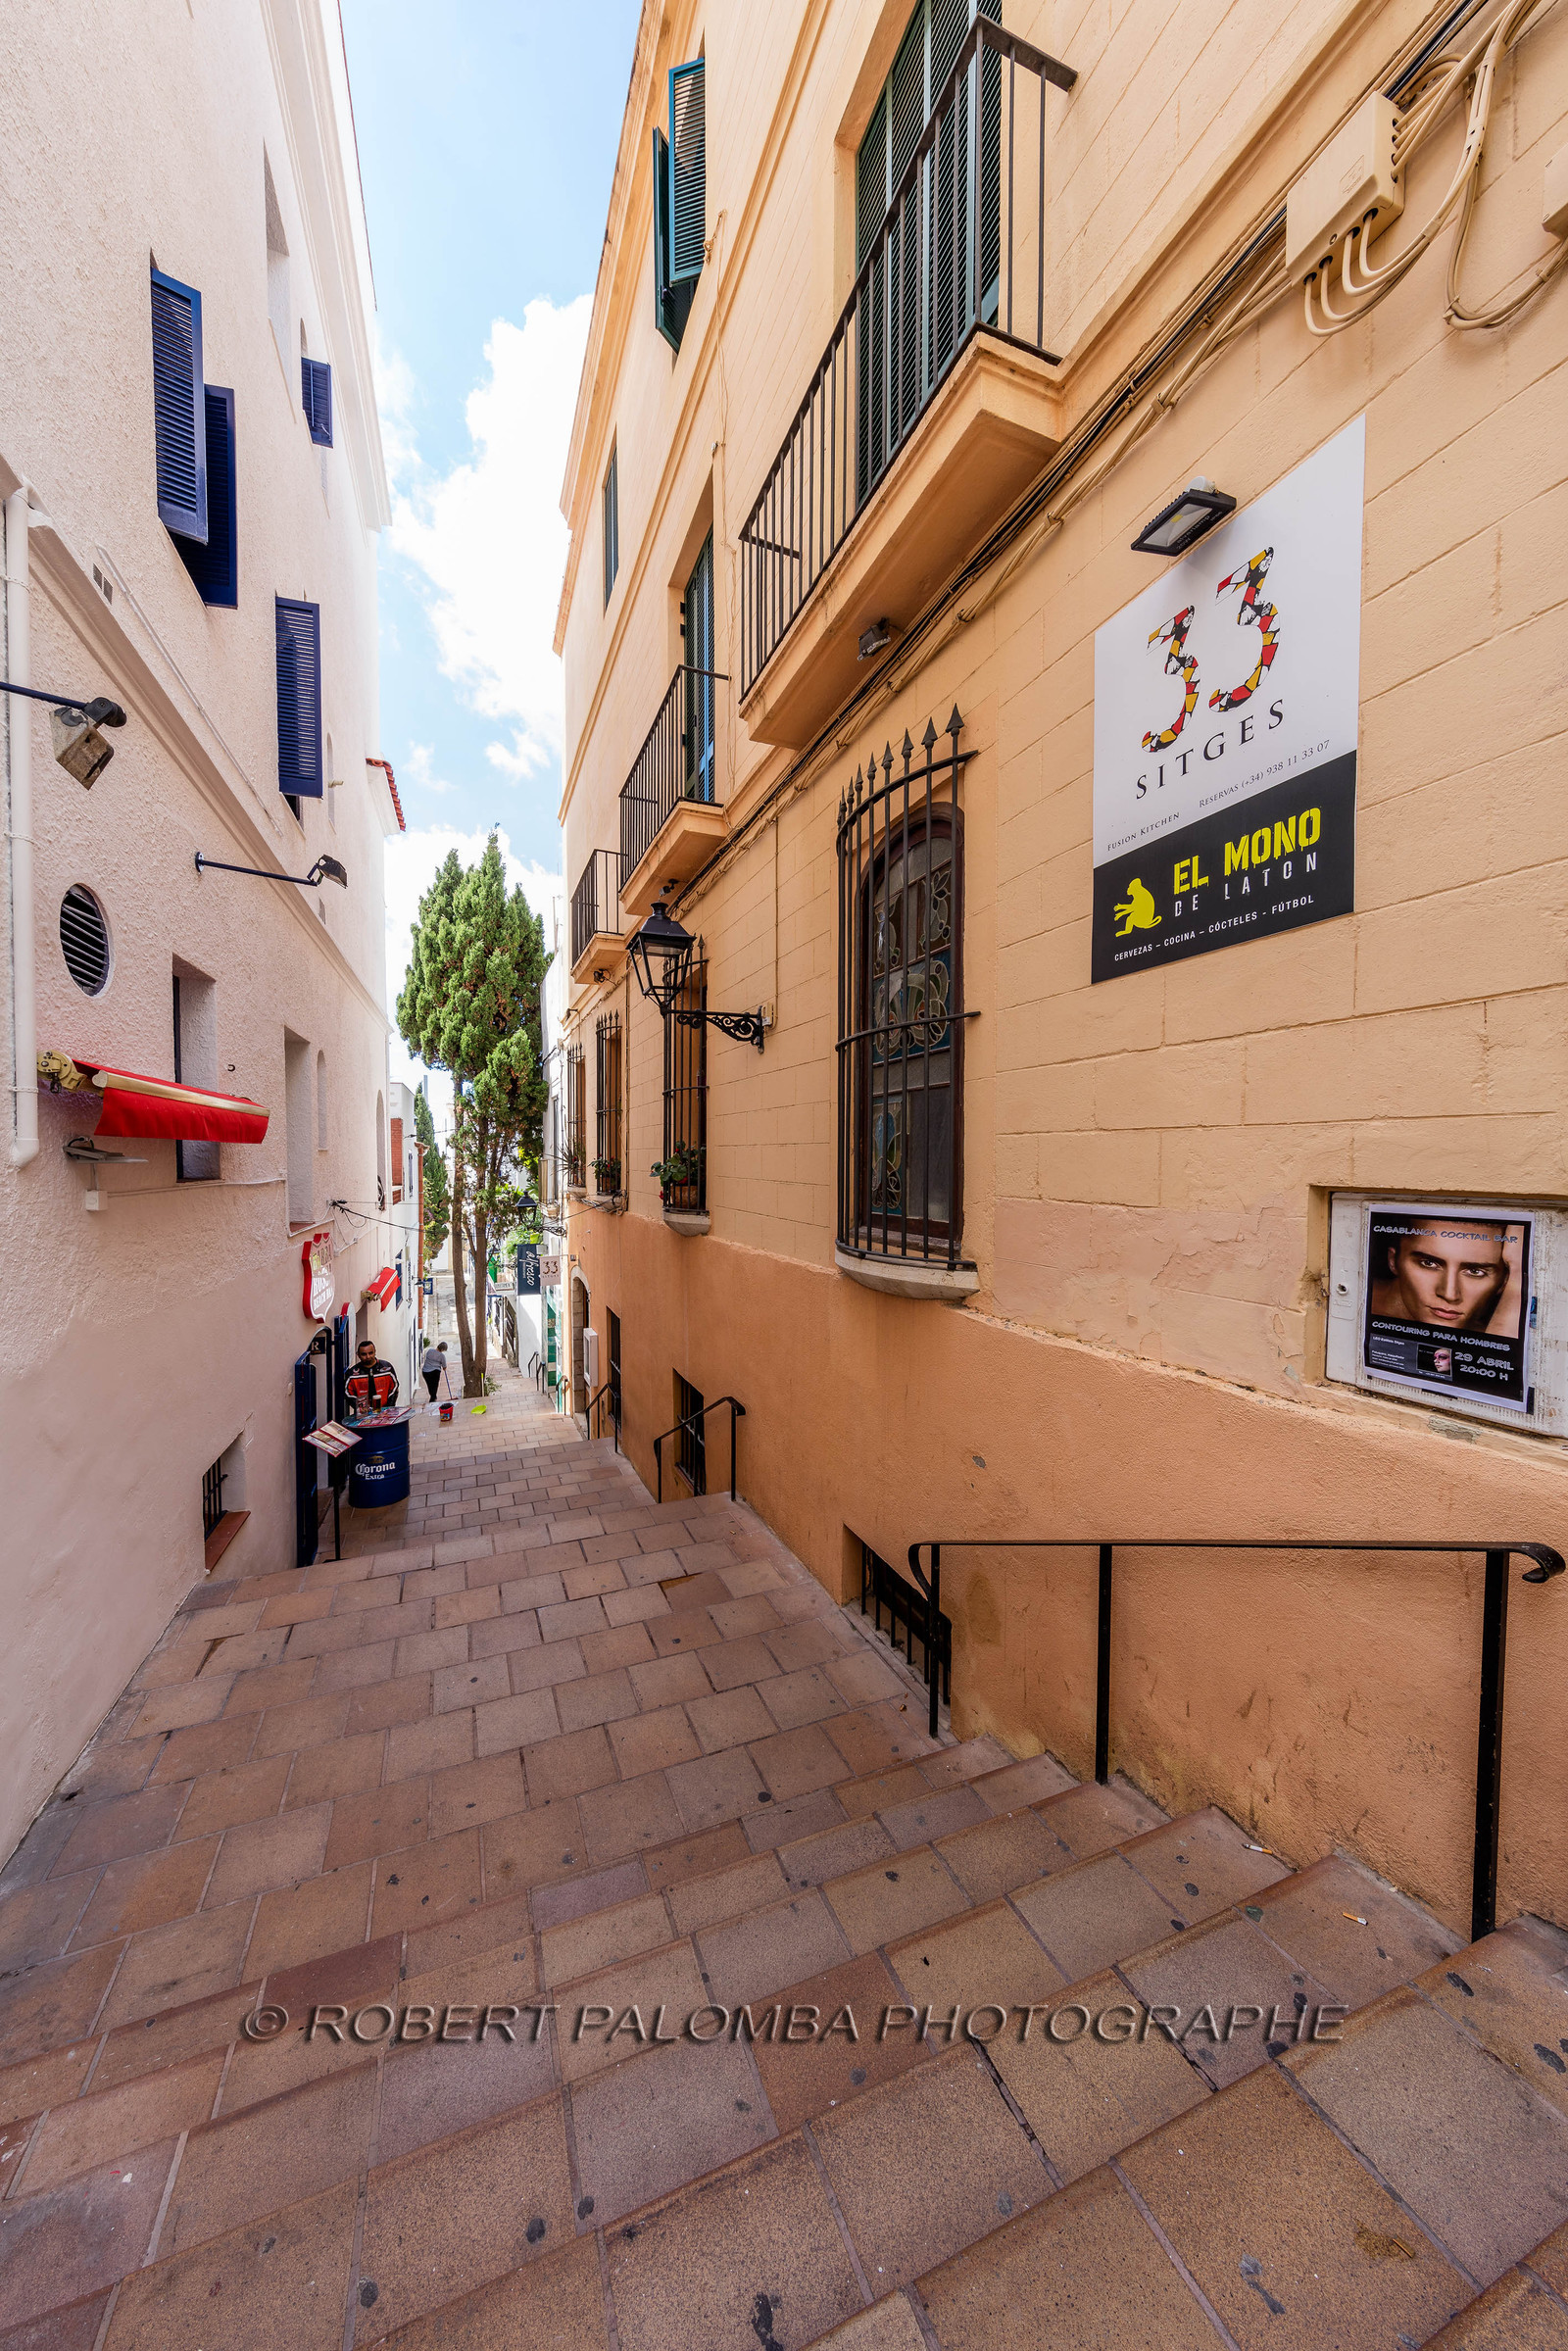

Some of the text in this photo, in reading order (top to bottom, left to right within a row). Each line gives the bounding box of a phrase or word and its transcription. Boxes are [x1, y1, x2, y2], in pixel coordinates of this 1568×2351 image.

[1141, 547, 1281, 753] 33
[1136, 699, 1284, 800] SITGES
[1199, 739, 1330, 808] RESERVAS (+34) 938 11 33 07
[1107, 811, 1180, 852] FUSION KITCHEN
[1174, 808, 1321, 895] EL MONO
[1174, 852, 1317, 917] DE LATON
[1114, 944, 1152, 961] CERVEZAS
[1164, 931, 1196, 947] COCINA
[1208, 911, 1257, 933] CÓCTELES
[1272, 895, 1314, 914] FÚTBOL
[1373, 1225, 1437, 1238] CASABLANCA
[1441, 1230, 1491, 1242] COCKTAIL
[542, 1260, 559, 1275] 33
[1372, 1321, 1511, 1351] CONTOURING PARA HOMBRES
[1454, 1351, 1514, 1371] 29 ABRIL
[1459, 1364, 1508, 1381] 20:00 H
[355, 1461, 396, 1476] Corona
